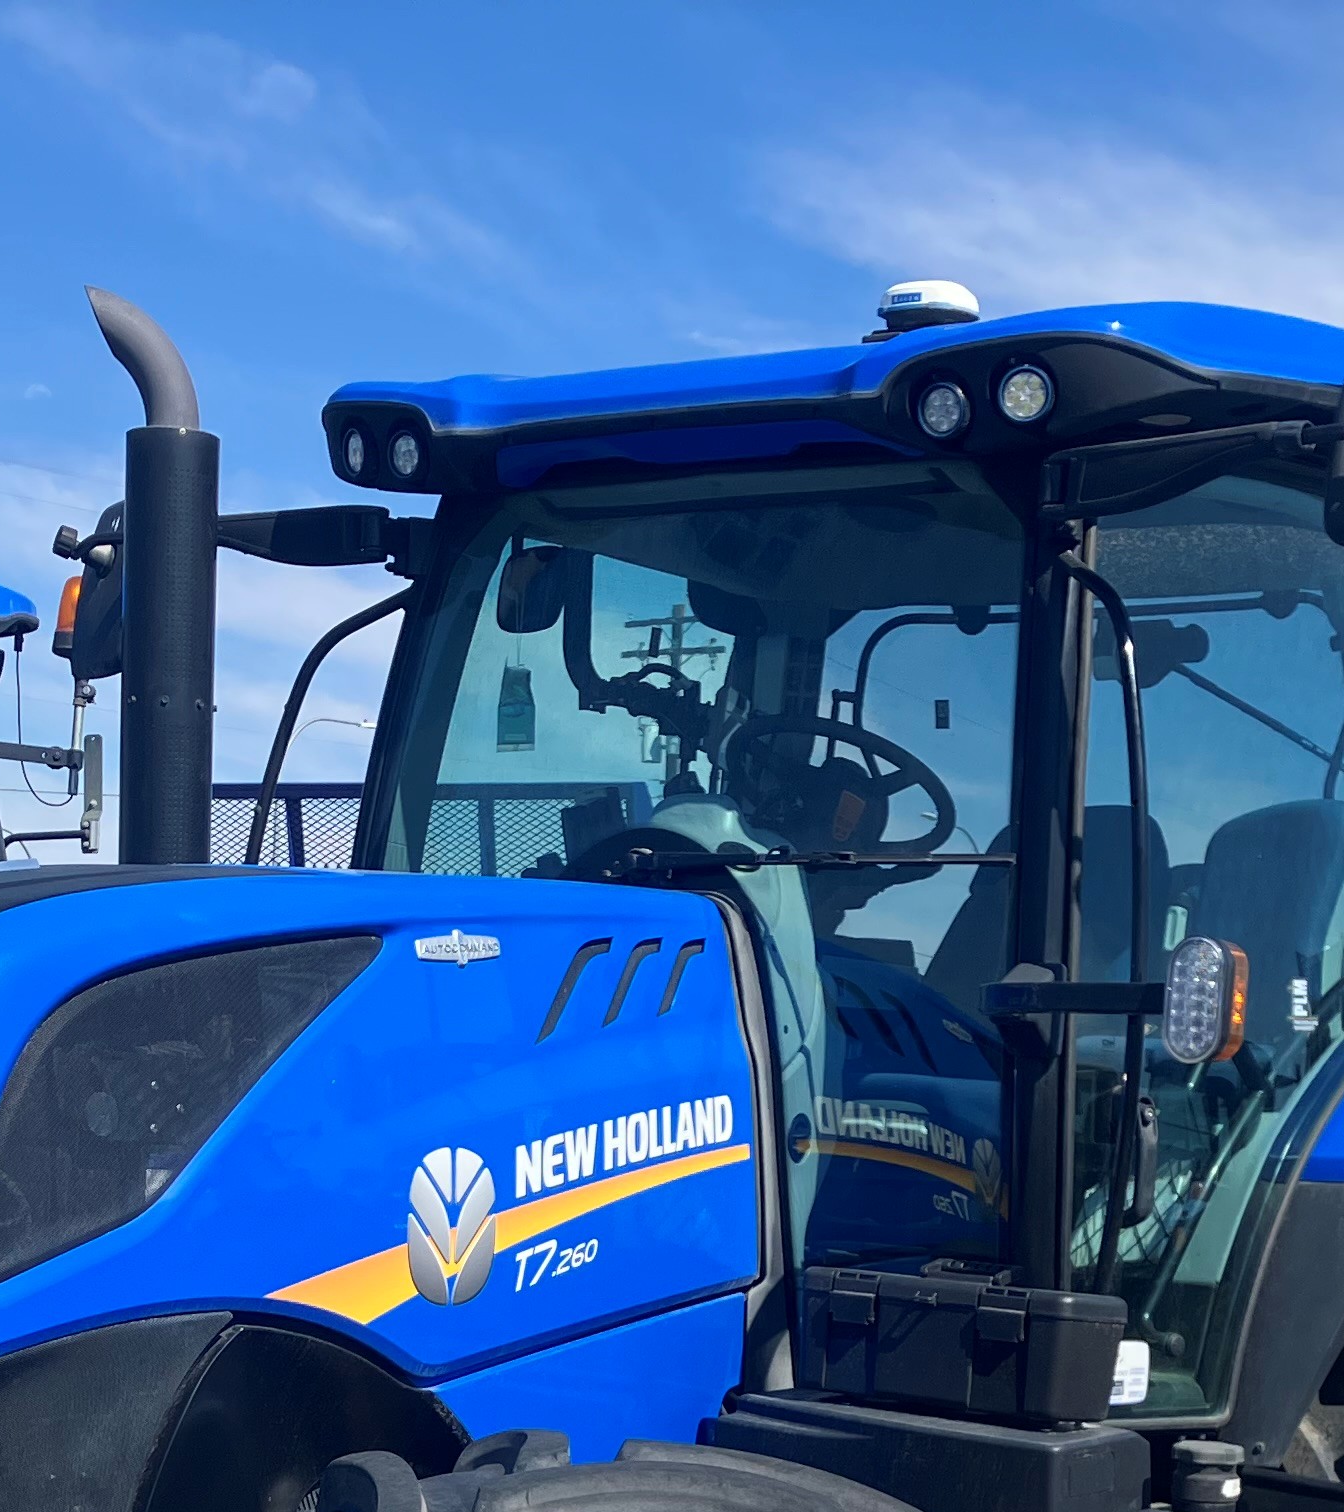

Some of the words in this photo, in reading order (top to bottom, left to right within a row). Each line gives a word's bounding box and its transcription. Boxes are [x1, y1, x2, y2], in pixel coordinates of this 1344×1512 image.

[514, 1126, 602, 1198] NEW
[604, 1094, 733, 1171] HOLLAND
[513, 1238, 599, 1292] T7.260
